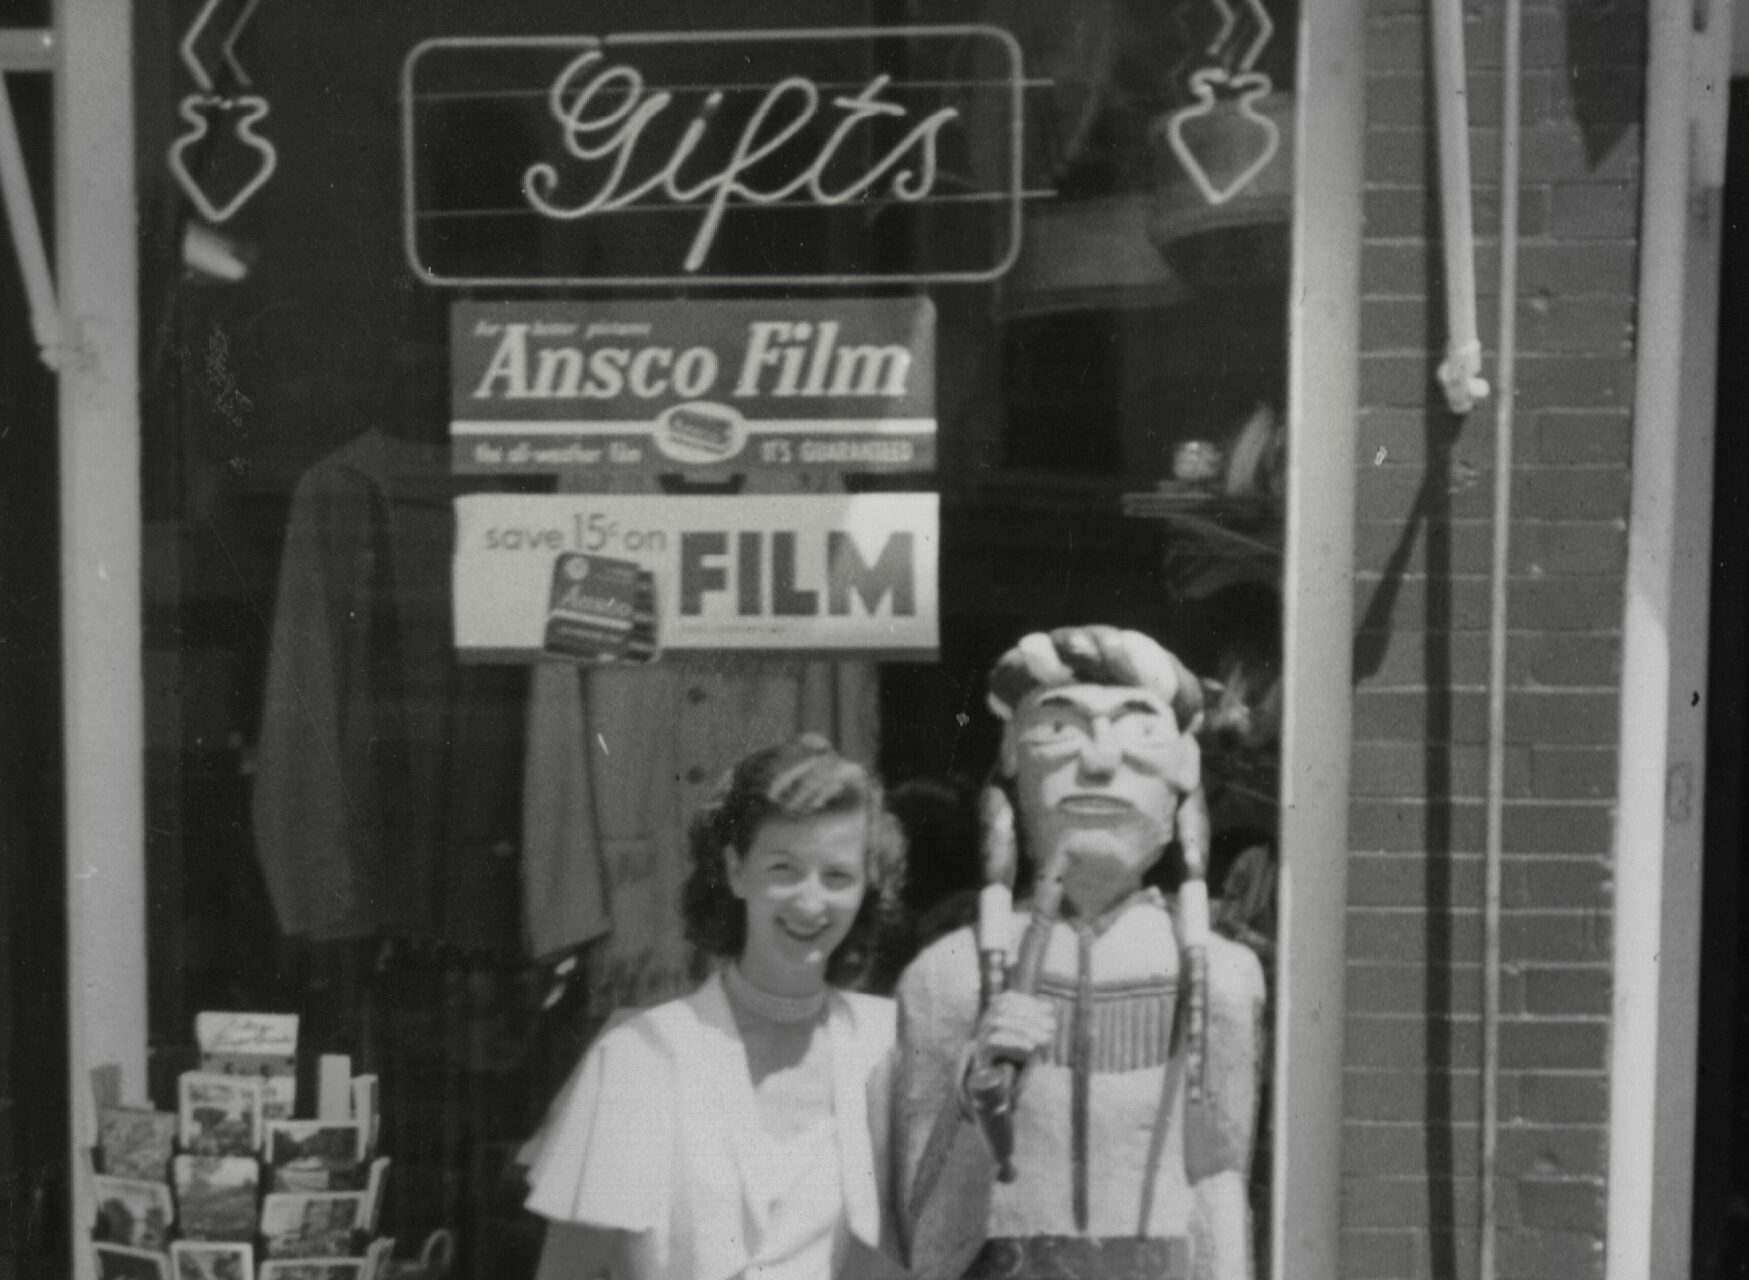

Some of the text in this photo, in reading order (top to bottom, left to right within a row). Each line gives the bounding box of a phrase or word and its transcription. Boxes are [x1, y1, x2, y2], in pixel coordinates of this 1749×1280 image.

[522, 50, 958, 271] Gifts
[473, 320, 911, 399] Ansco Film
[485, 528, 564, 550] save
[624, 529, 667, 551] on
[680, 531, 915, 616] FILM
